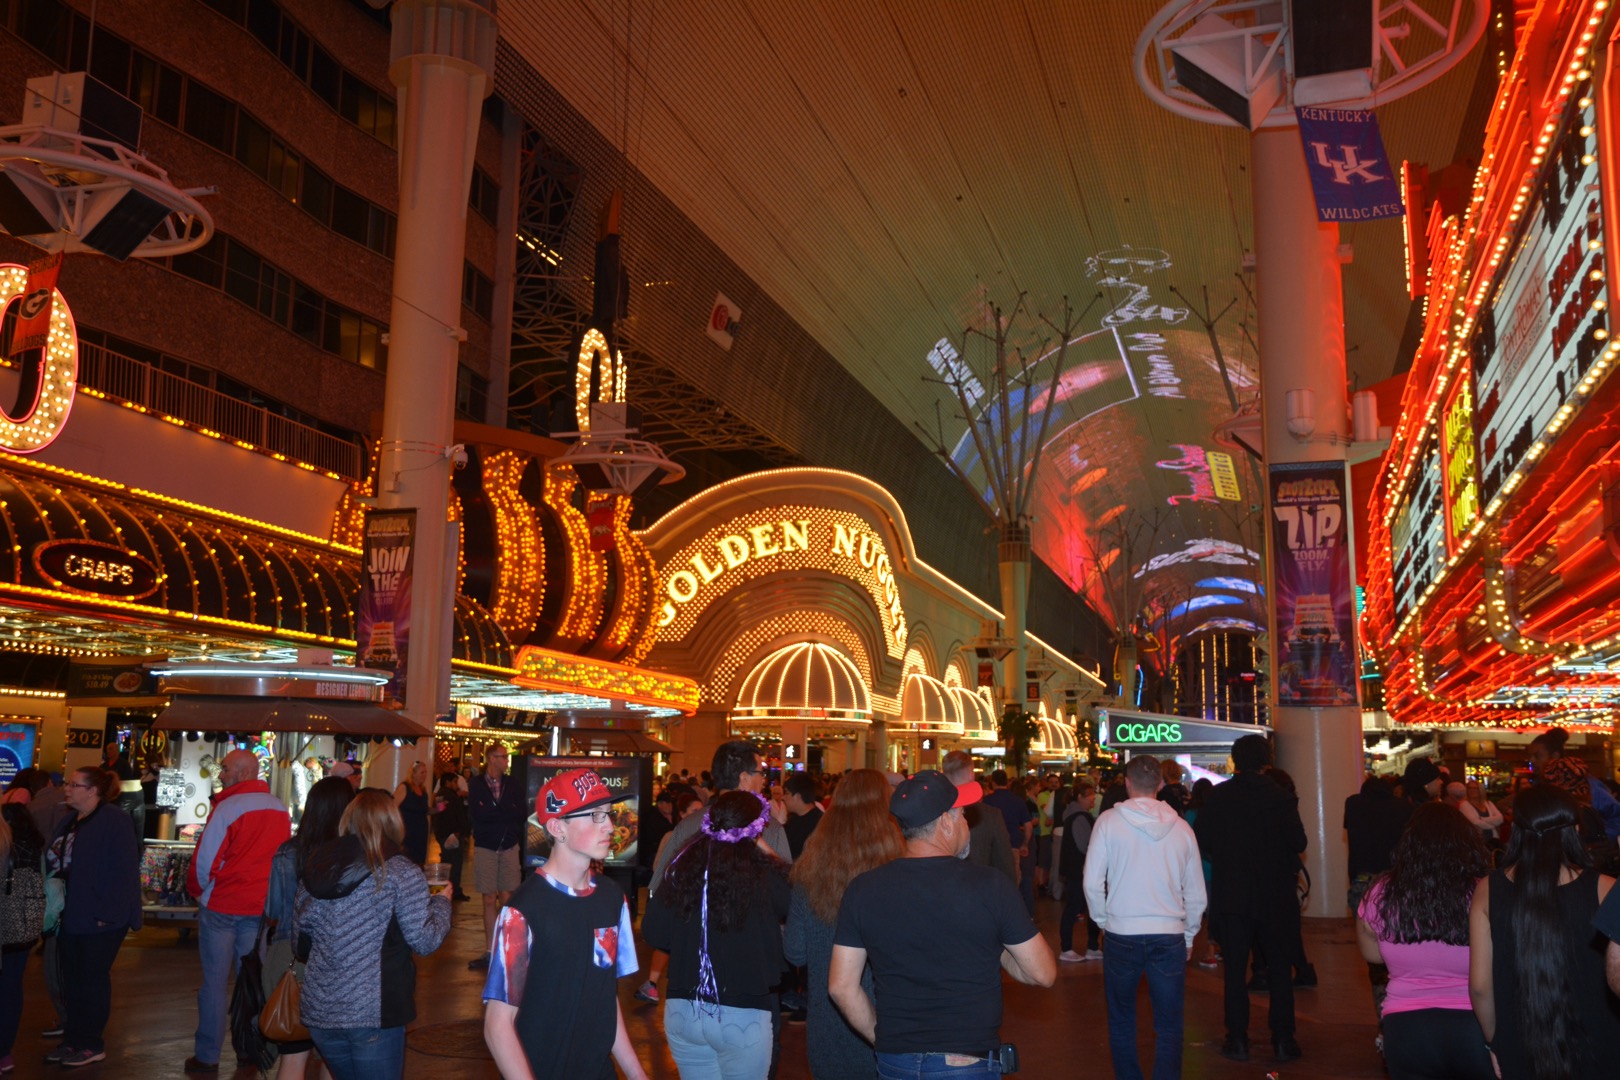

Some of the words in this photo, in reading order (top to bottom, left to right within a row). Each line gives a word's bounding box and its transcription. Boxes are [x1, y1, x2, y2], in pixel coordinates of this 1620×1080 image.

[1301, 107, 1372, 122] KENTUCKY
[1310, 142, 1385, 185] UK
[1320, 203, 1401, 219] WILDCATS
[367, 546, 410, 573] JOIN
[1291, 550, 1330, 561] ZOOM.
[65, 554, 134, 585] CRAPS
[371, 573, 400, 592] THE
[832, 523, 907, 646] NUGGET
[316, 682, 348, 697] DESIGNER
[69, 731, 101, 745] 202
[1116, 723, 1182, 743] CIGARS
